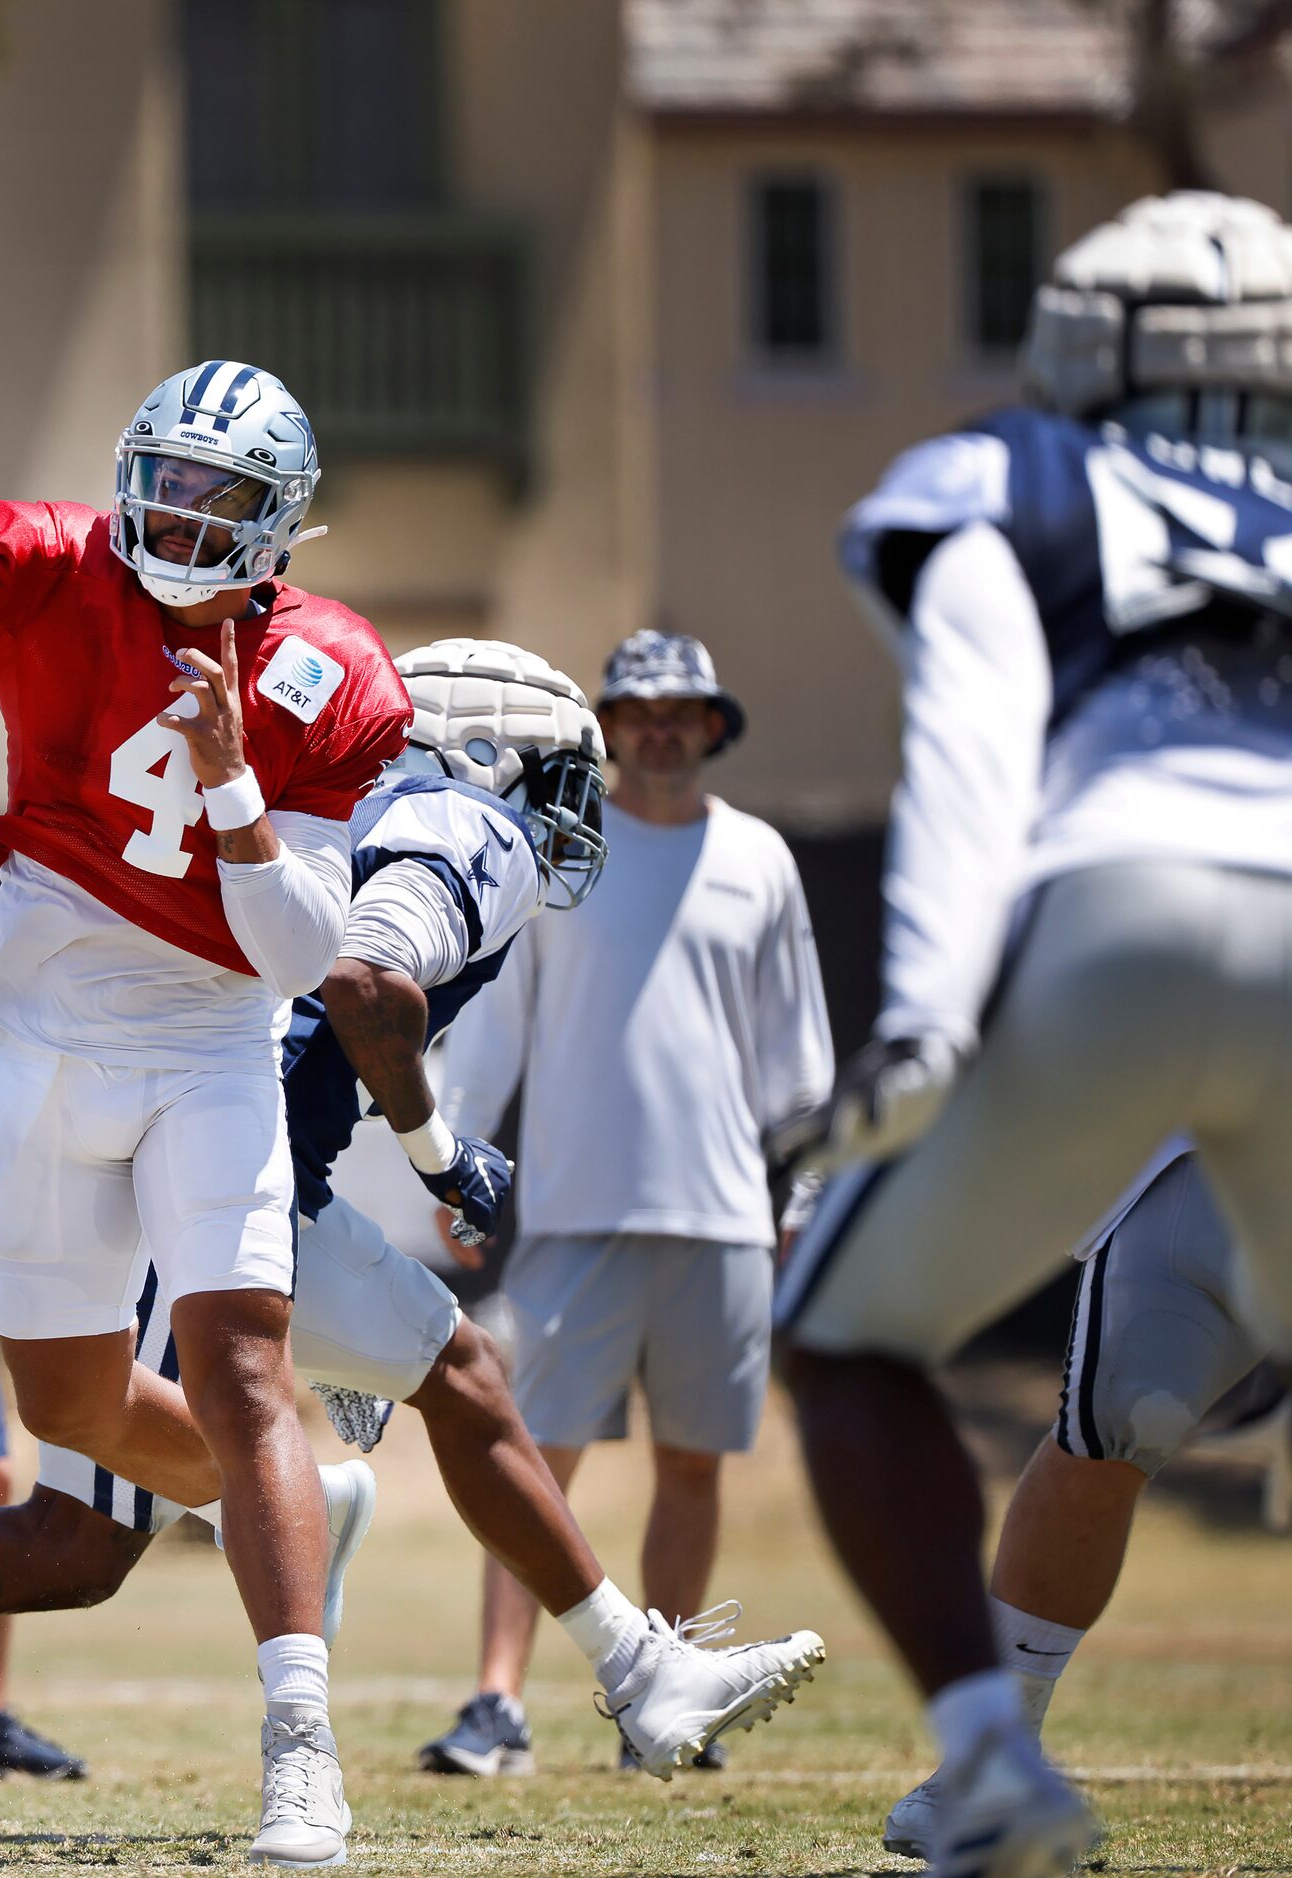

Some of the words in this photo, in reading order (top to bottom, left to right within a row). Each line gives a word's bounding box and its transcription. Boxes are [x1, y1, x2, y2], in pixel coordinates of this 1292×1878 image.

[180, 431, 219, 446] COWBOYS
[272, 680, 312, 708] AT&T
[108, 691, 205, 879] 4
